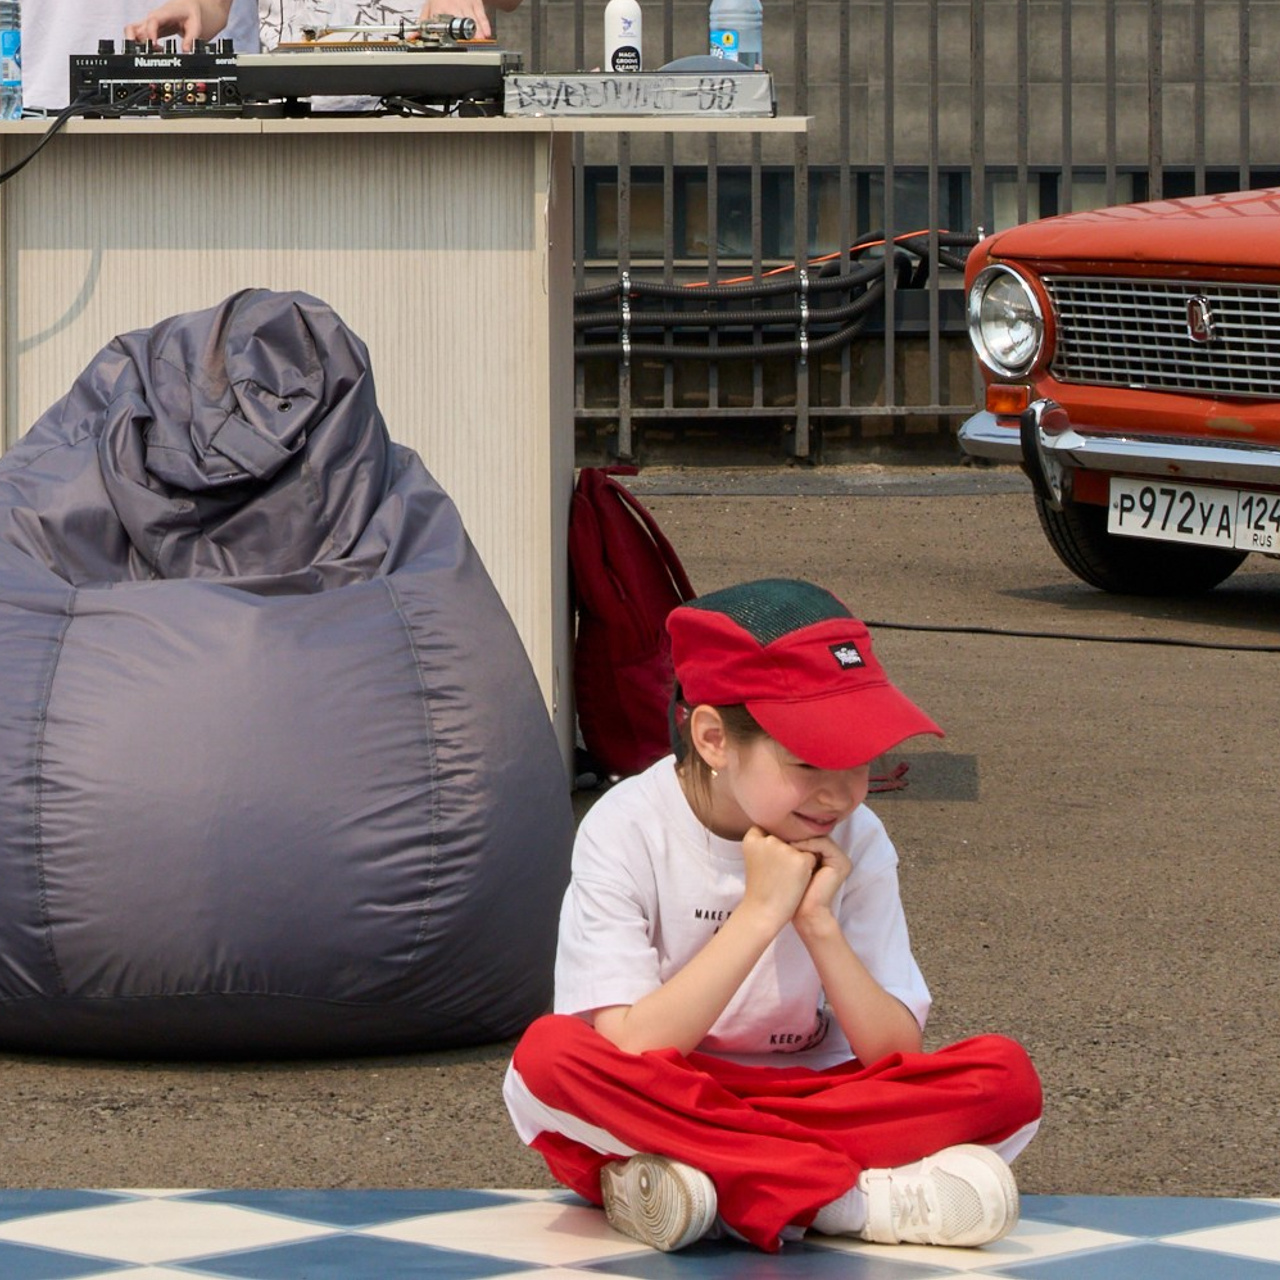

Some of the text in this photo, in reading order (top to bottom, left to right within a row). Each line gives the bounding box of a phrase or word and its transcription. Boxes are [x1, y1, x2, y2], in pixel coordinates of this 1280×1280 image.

[134, 56, 182, 68] Numark
[215, 57, 237, 66] serat
[1252, 534, 1273, 548] RUS
[695, 908, 723, 921] MAKE
[769, 1033, 802, 1045] KEEP
